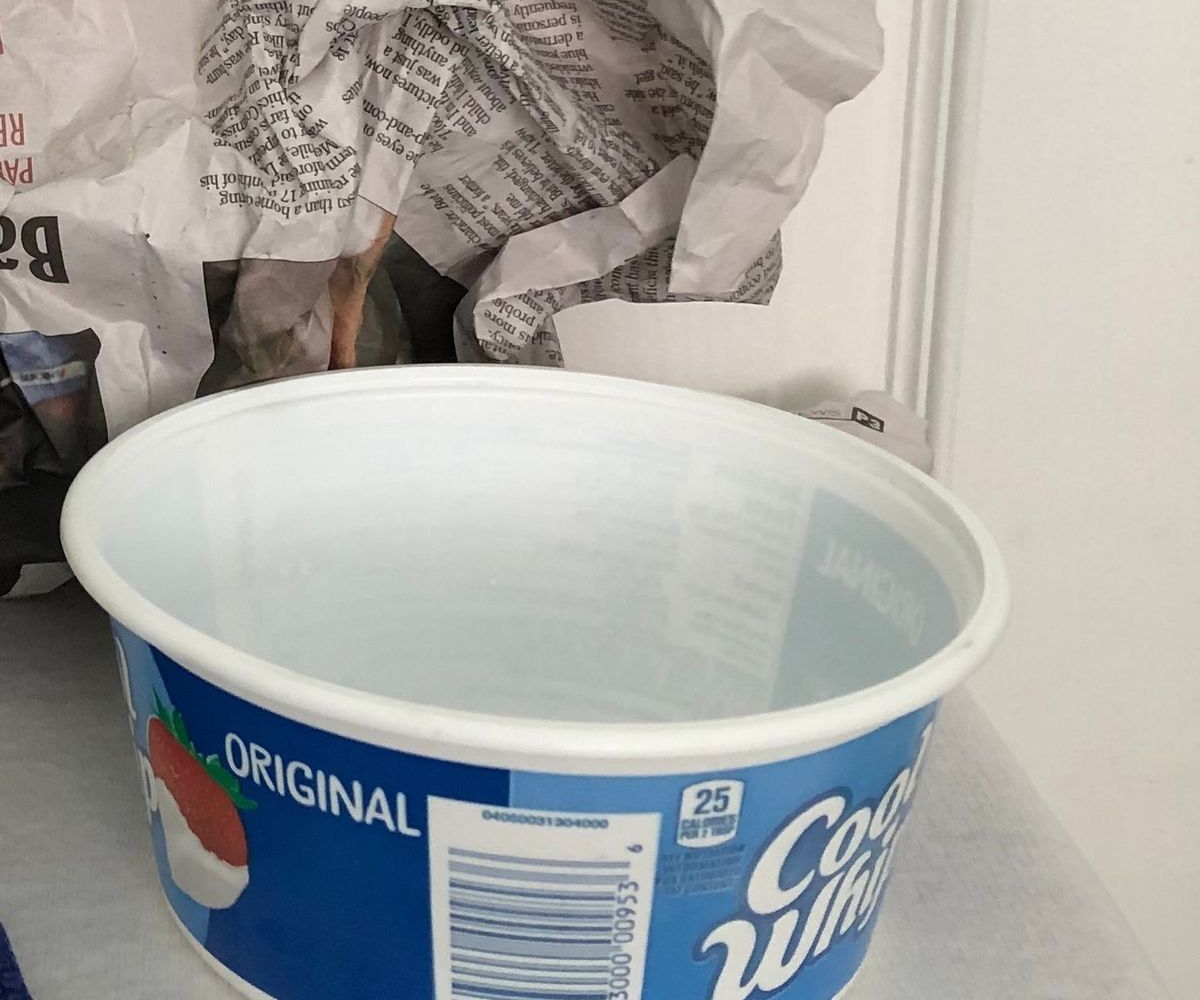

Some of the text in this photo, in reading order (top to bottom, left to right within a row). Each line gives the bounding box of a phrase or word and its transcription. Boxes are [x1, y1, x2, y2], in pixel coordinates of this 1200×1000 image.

[224, 732, 421, 838] ORIGINAL
[694, 786, 732, 815] 25
[626, 843, 643, 854] 6
[614, 881, 640, 944] 00953
